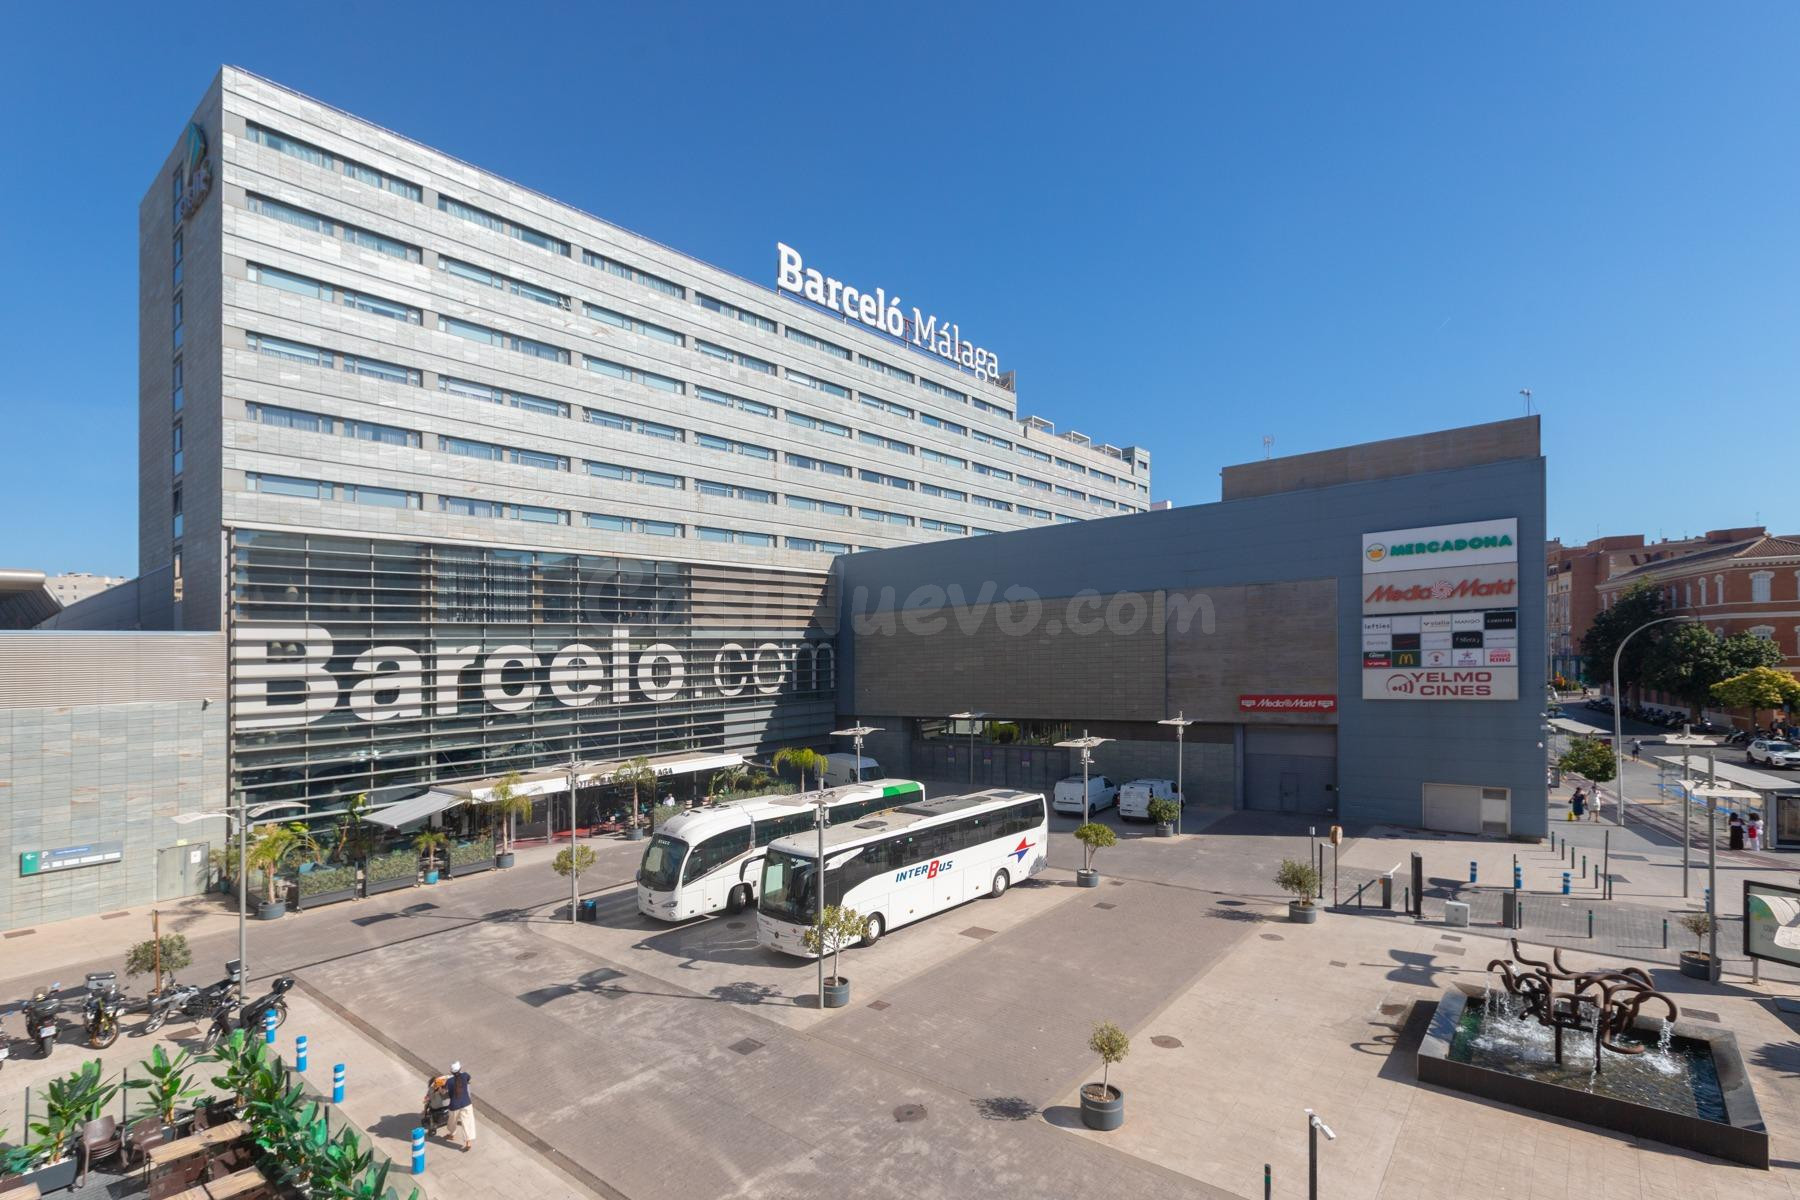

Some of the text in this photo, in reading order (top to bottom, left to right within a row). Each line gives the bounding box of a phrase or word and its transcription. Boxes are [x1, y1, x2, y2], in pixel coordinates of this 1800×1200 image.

[777, 242, 1000, 382] Barceló Málaga
[1390, 535, 1513, 557] MERCADONA
[1365, 578, 1517, 604] Media Markt
[234, 623, 836, 727] Barcelo.com
[1411, 672, 1492, 683] YELMO
[1419, 684, 1492, 696] CINES
[895, 860, 953, 883] INTERBUS
